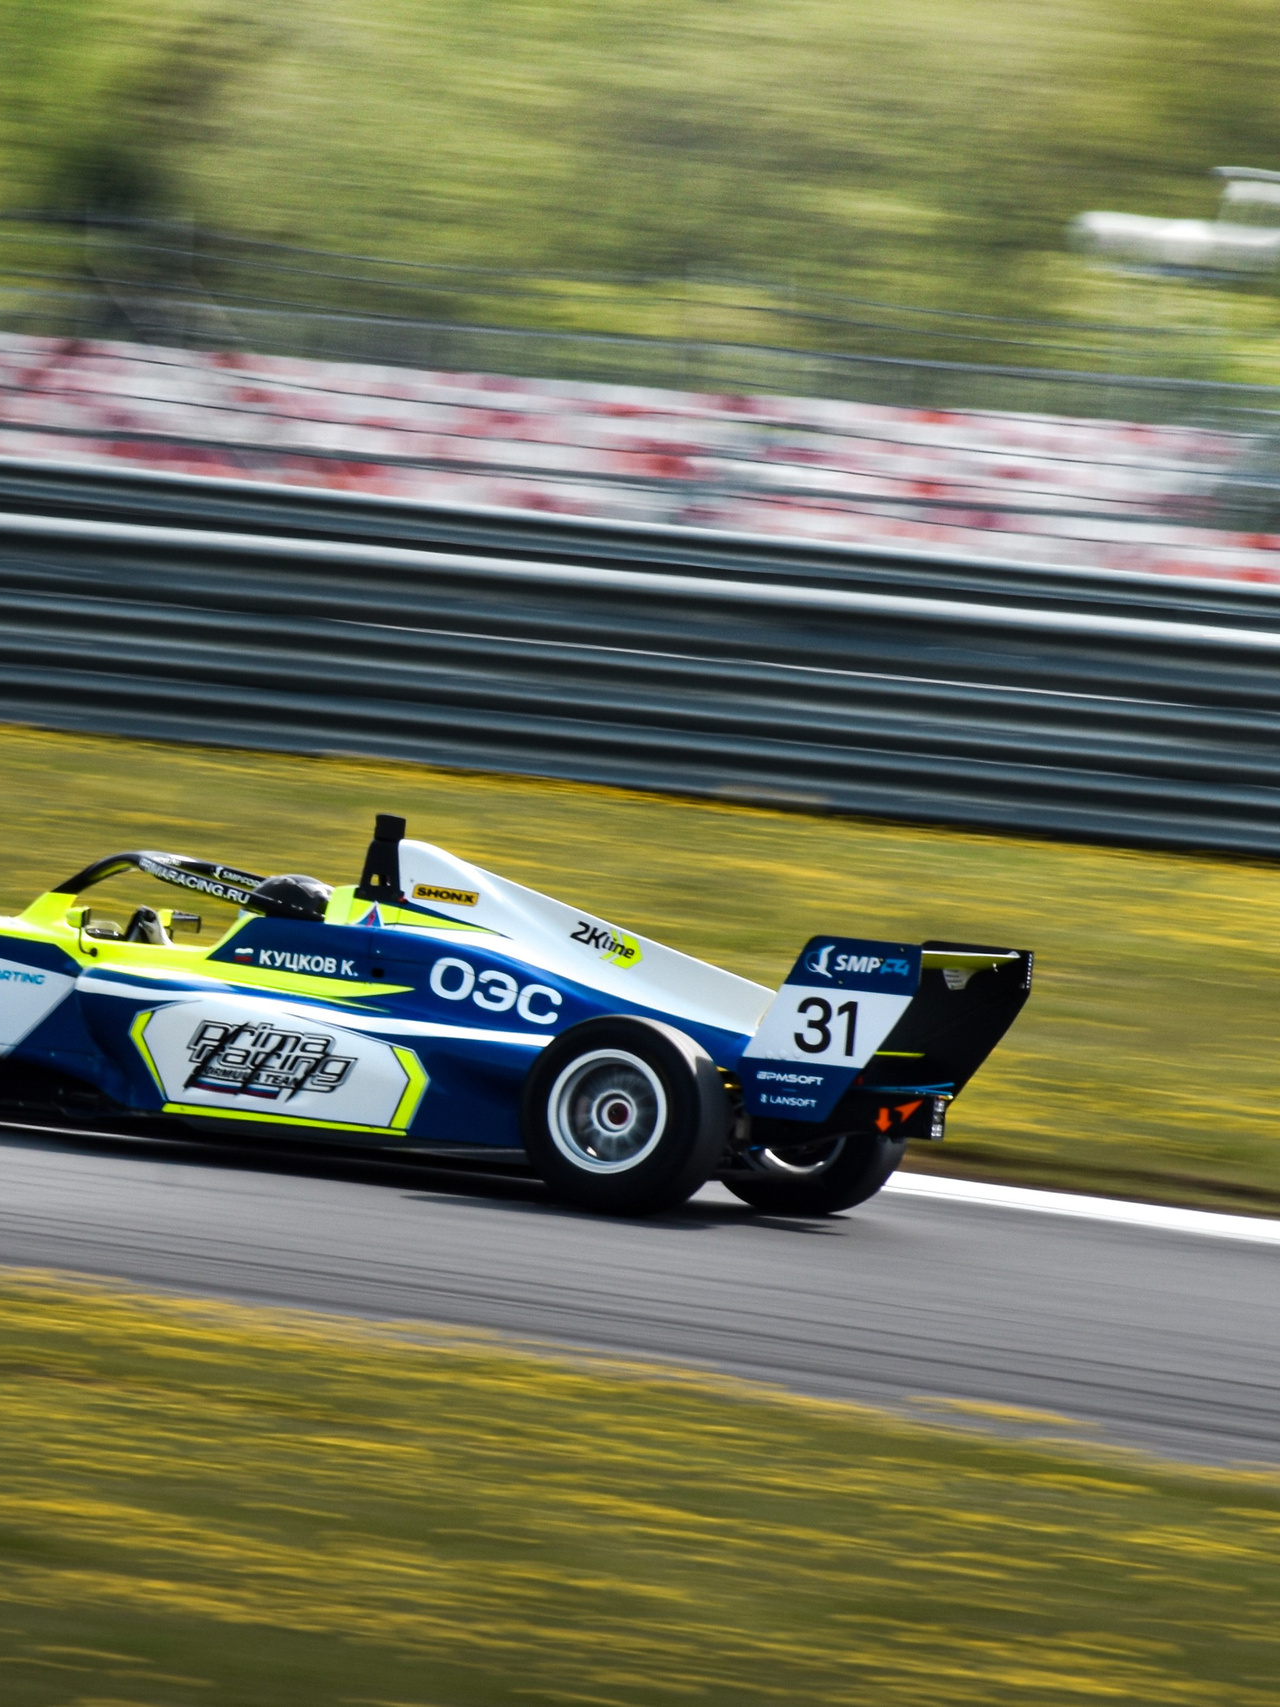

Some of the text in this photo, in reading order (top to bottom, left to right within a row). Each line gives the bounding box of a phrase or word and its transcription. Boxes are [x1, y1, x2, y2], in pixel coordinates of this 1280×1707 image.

[417, 886, 475, 904] SHONX
[259, 949, 359, 977] КУЦКОВ К.
[794, 997, 859, 1057] 31
[769, 1095, 818, 1108] LANSOFT
